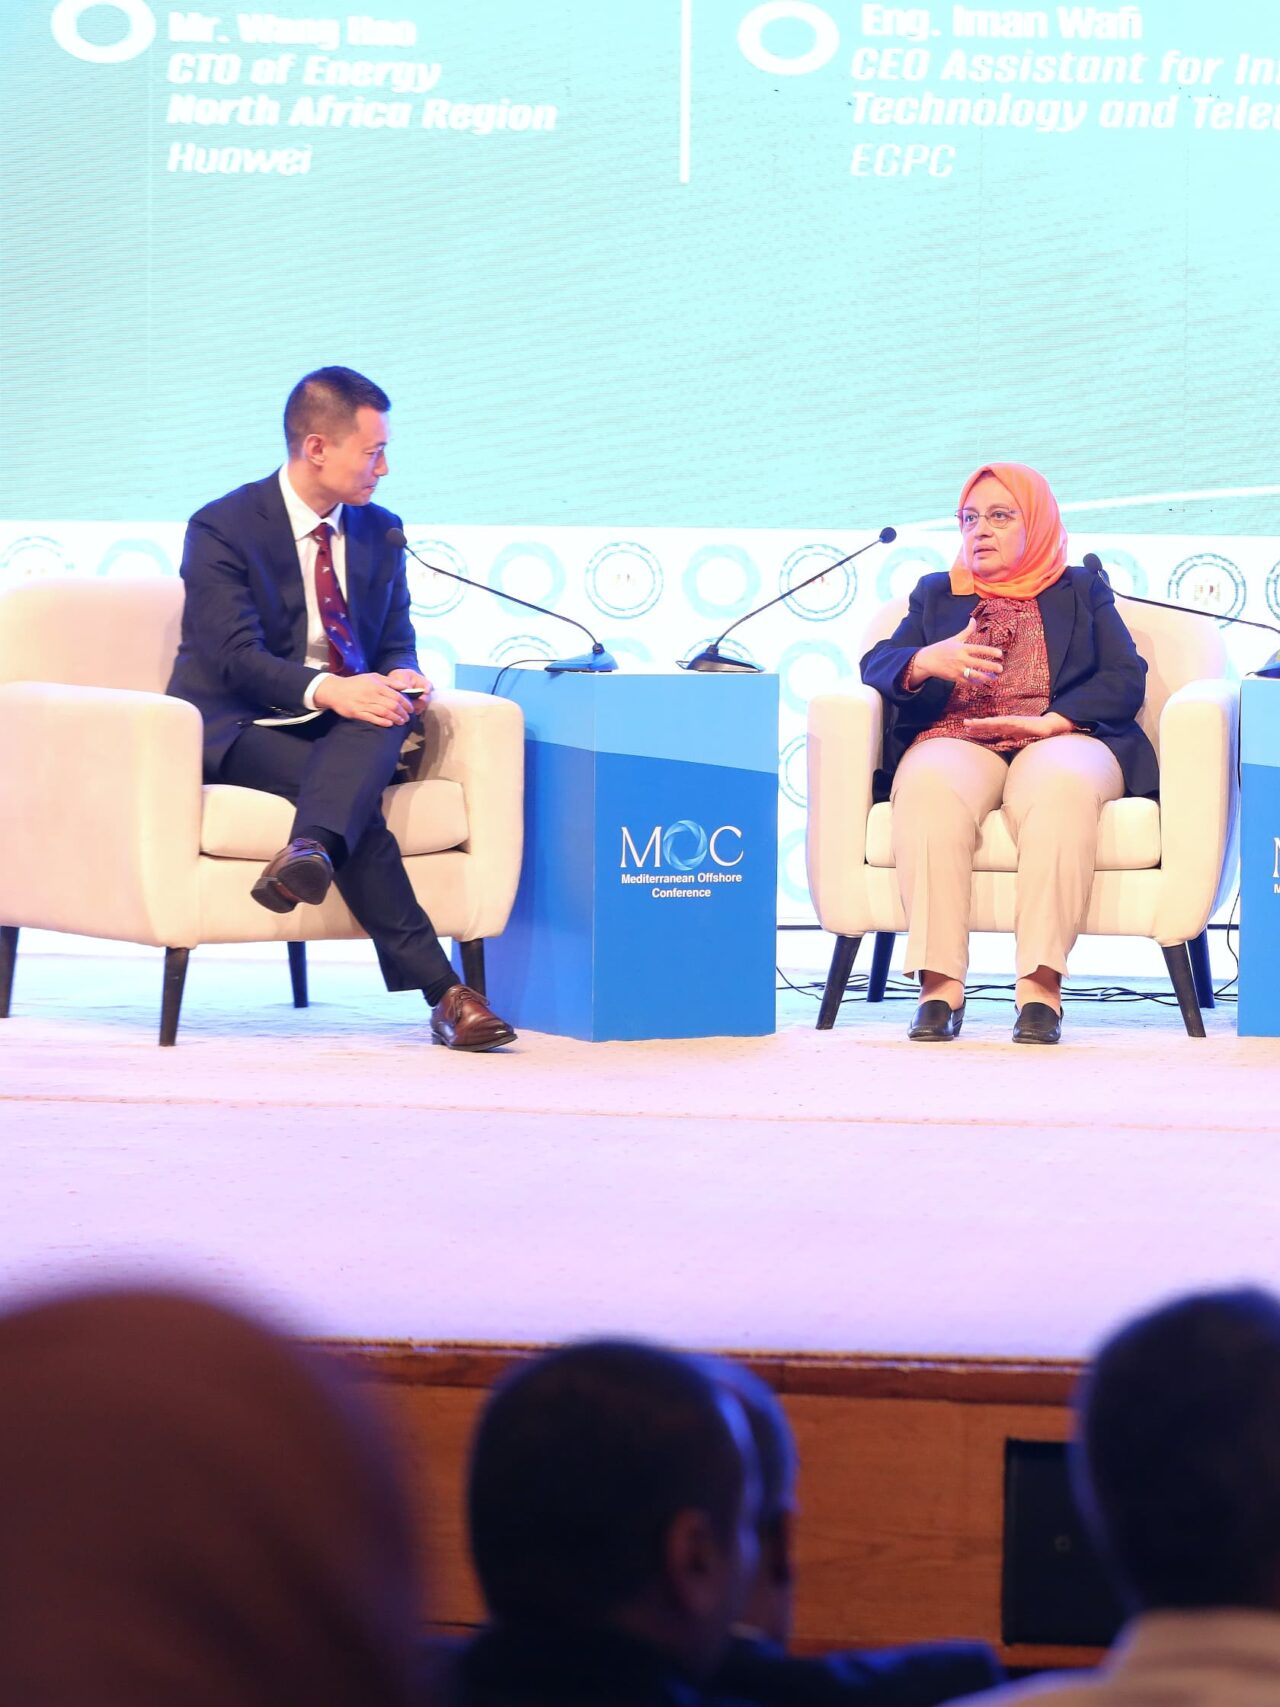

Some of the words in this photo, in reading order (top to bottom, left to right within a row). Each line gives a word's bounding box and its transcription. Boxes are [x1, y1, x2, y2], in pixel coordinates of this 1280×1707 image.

[168, 12, 230, 42] Mr.
[861, 3, 942, 42] Eng.
[952, 5, 1048, 38] Iman
[167, 53, 241, 84] CTO
[250, 54, 296, 84] of
[303, 56, 442, 93] Energy
[850, 48, 931, 81] CEO
[939, 49, 1149, 84] Assistant
[1159, 50, 1224, 84] for
[166, 94, 281, 126] North
[288, 96, 412, 128] Africa
[422, 98, 558, 135] Region
[851, 92, 1089, 132] Technology
[1099, 96, 1180, 129] and
[167, 143, 312, 175] Huawei
[620, 820, 744, 870] MOC
[621, 873, 695, 884] Mediterranean
[697, 872, 743, 883] Offshore
[651, 888, 711, 898] Conference
